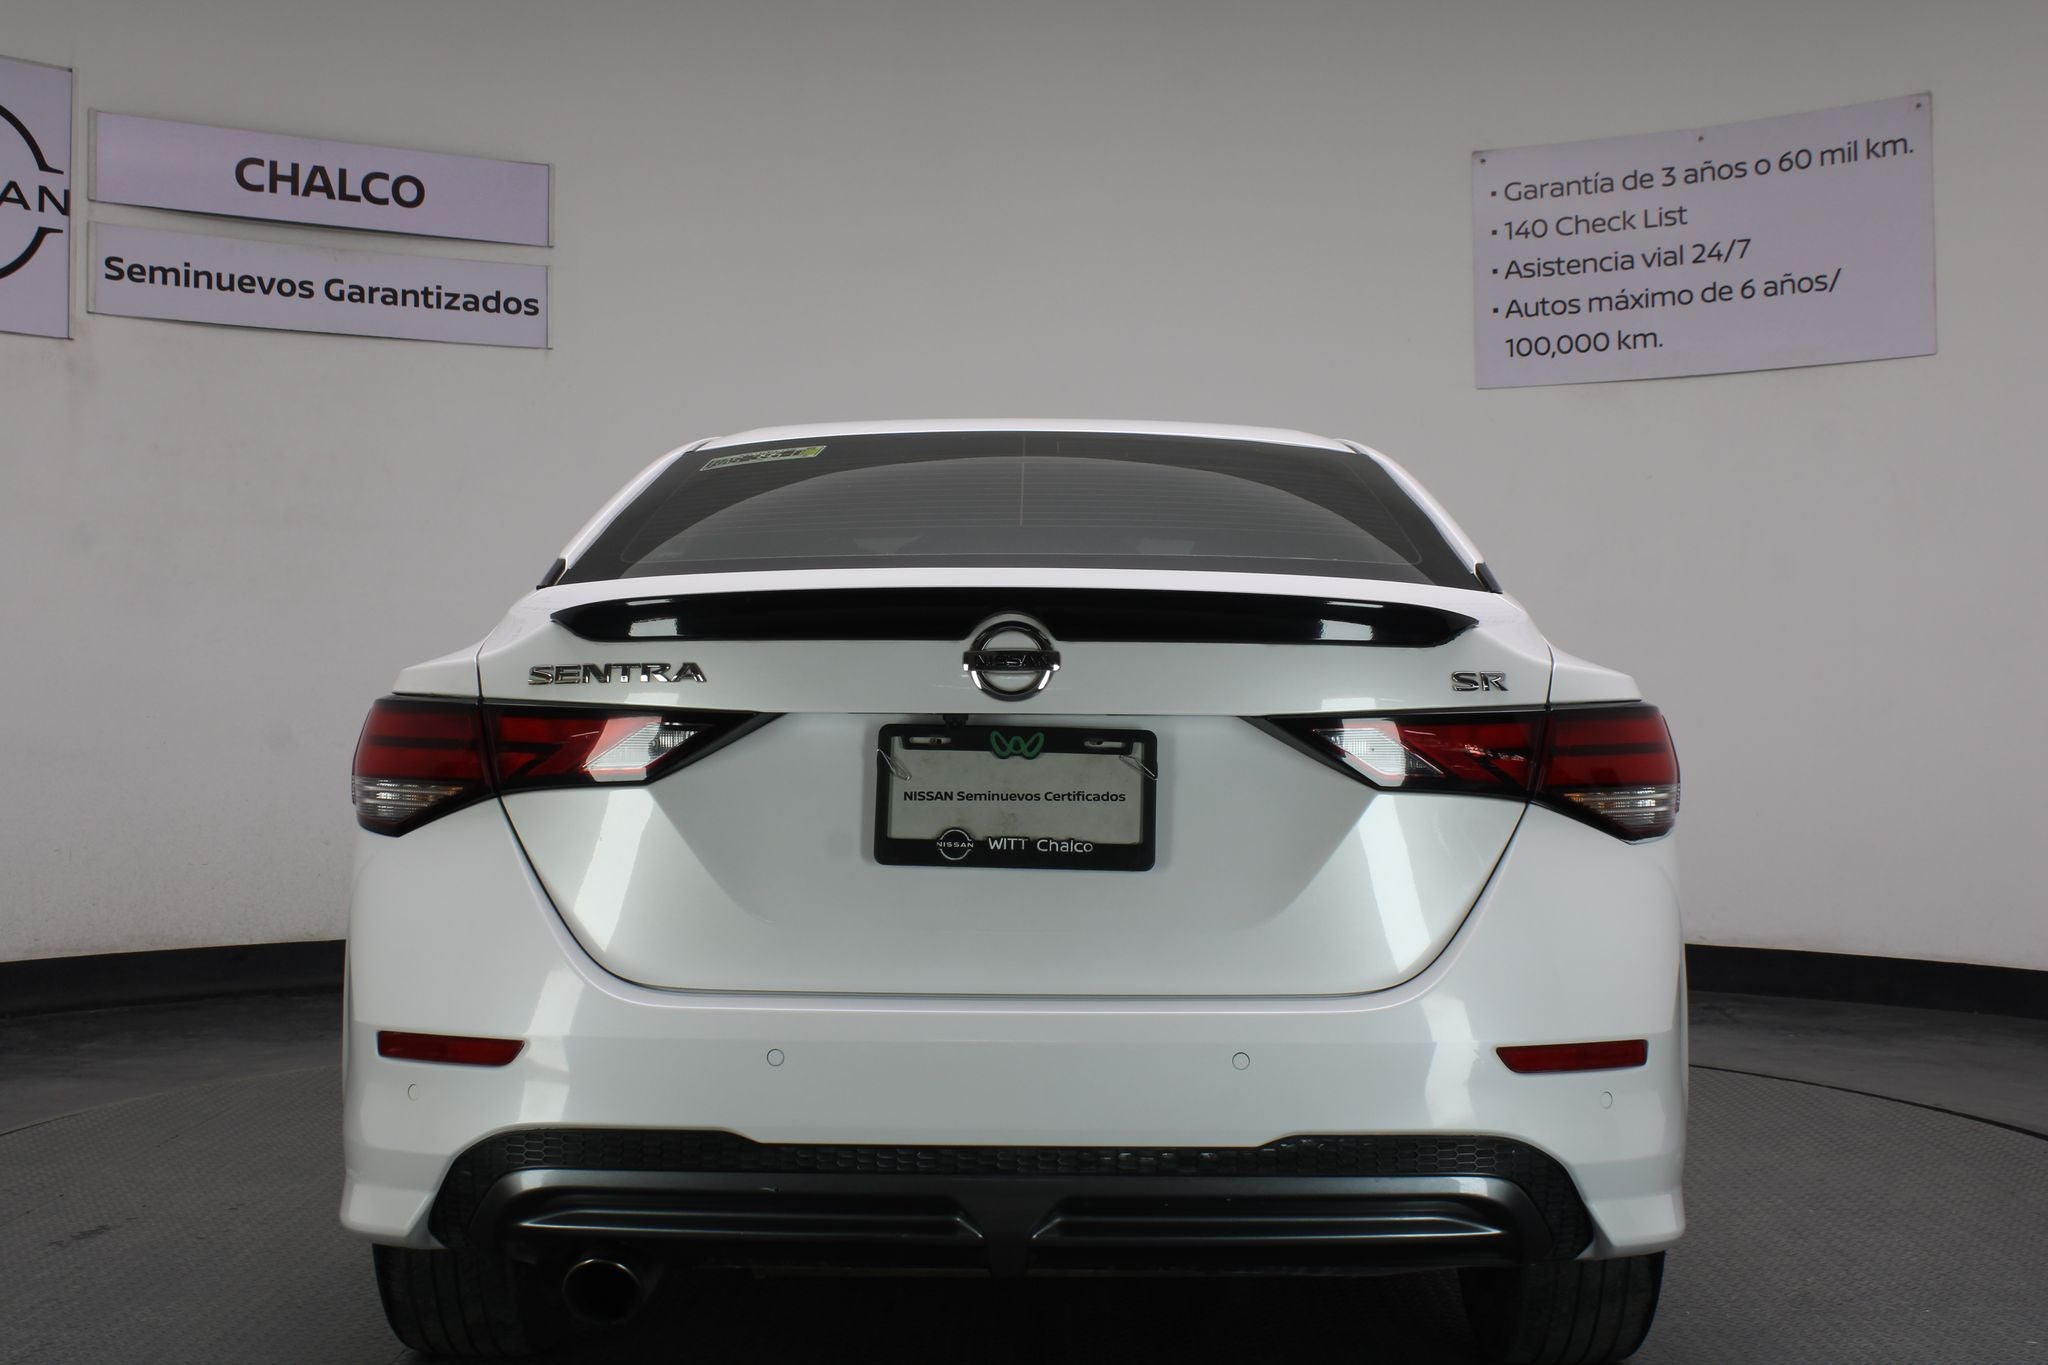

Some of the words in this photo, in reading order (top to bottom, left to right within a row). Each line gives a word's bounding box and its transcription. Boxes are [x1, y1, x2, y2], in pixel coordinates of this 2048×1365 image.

[234, 157, 426, 208] CHALCO
[1504, 171, 1615, 202] Garantía
[1621, 167, 1655, 190] de
[1661, 166, 1676, 187] 3
[1683, 156, 1747, 184] años
[1755, 157, 1771, 176] o
[1778, 149, 1812, 171] 60
[1819, 140, 1858, 168] mil
[1865, 136, 1914, 160] km.
[1505, 219, 1548, 241] 140
[1555, 210, 1637, 238] Check
[1643, 206, 1688, 229] List
[1504, 250, 1635, 280] Asistencia
[1641, 245, 1685, 269] vial
[1691, 238, 1751, 265] 24/7
[104, 255, 314, 299] Seminuevos
[324, 278, 540, 317] Garantizados
[1505, 294, 1581, 319] Autos
[1587, 286, 1694, 314] máximo
[1700, 281, 1734, 303] de
[1740, 279, 1756, 300] 6
[1763, 268, 1842, 297] años/
[1505, 332, 1610, 359] 100,000
[1617, 329, 1663, 351] km.
[528, 662, 707, 686] SENTRA
[1451, 671, 1509, 692] SR
[903, 790, 954, 801] NISSAN
[956, 791, 1040, 802] Seminuevos
[1044, 791, 1126, 802] Certificados
[988, 838, 1028, 850] WITT
[1036, 839, 1094, 853] Chalco
